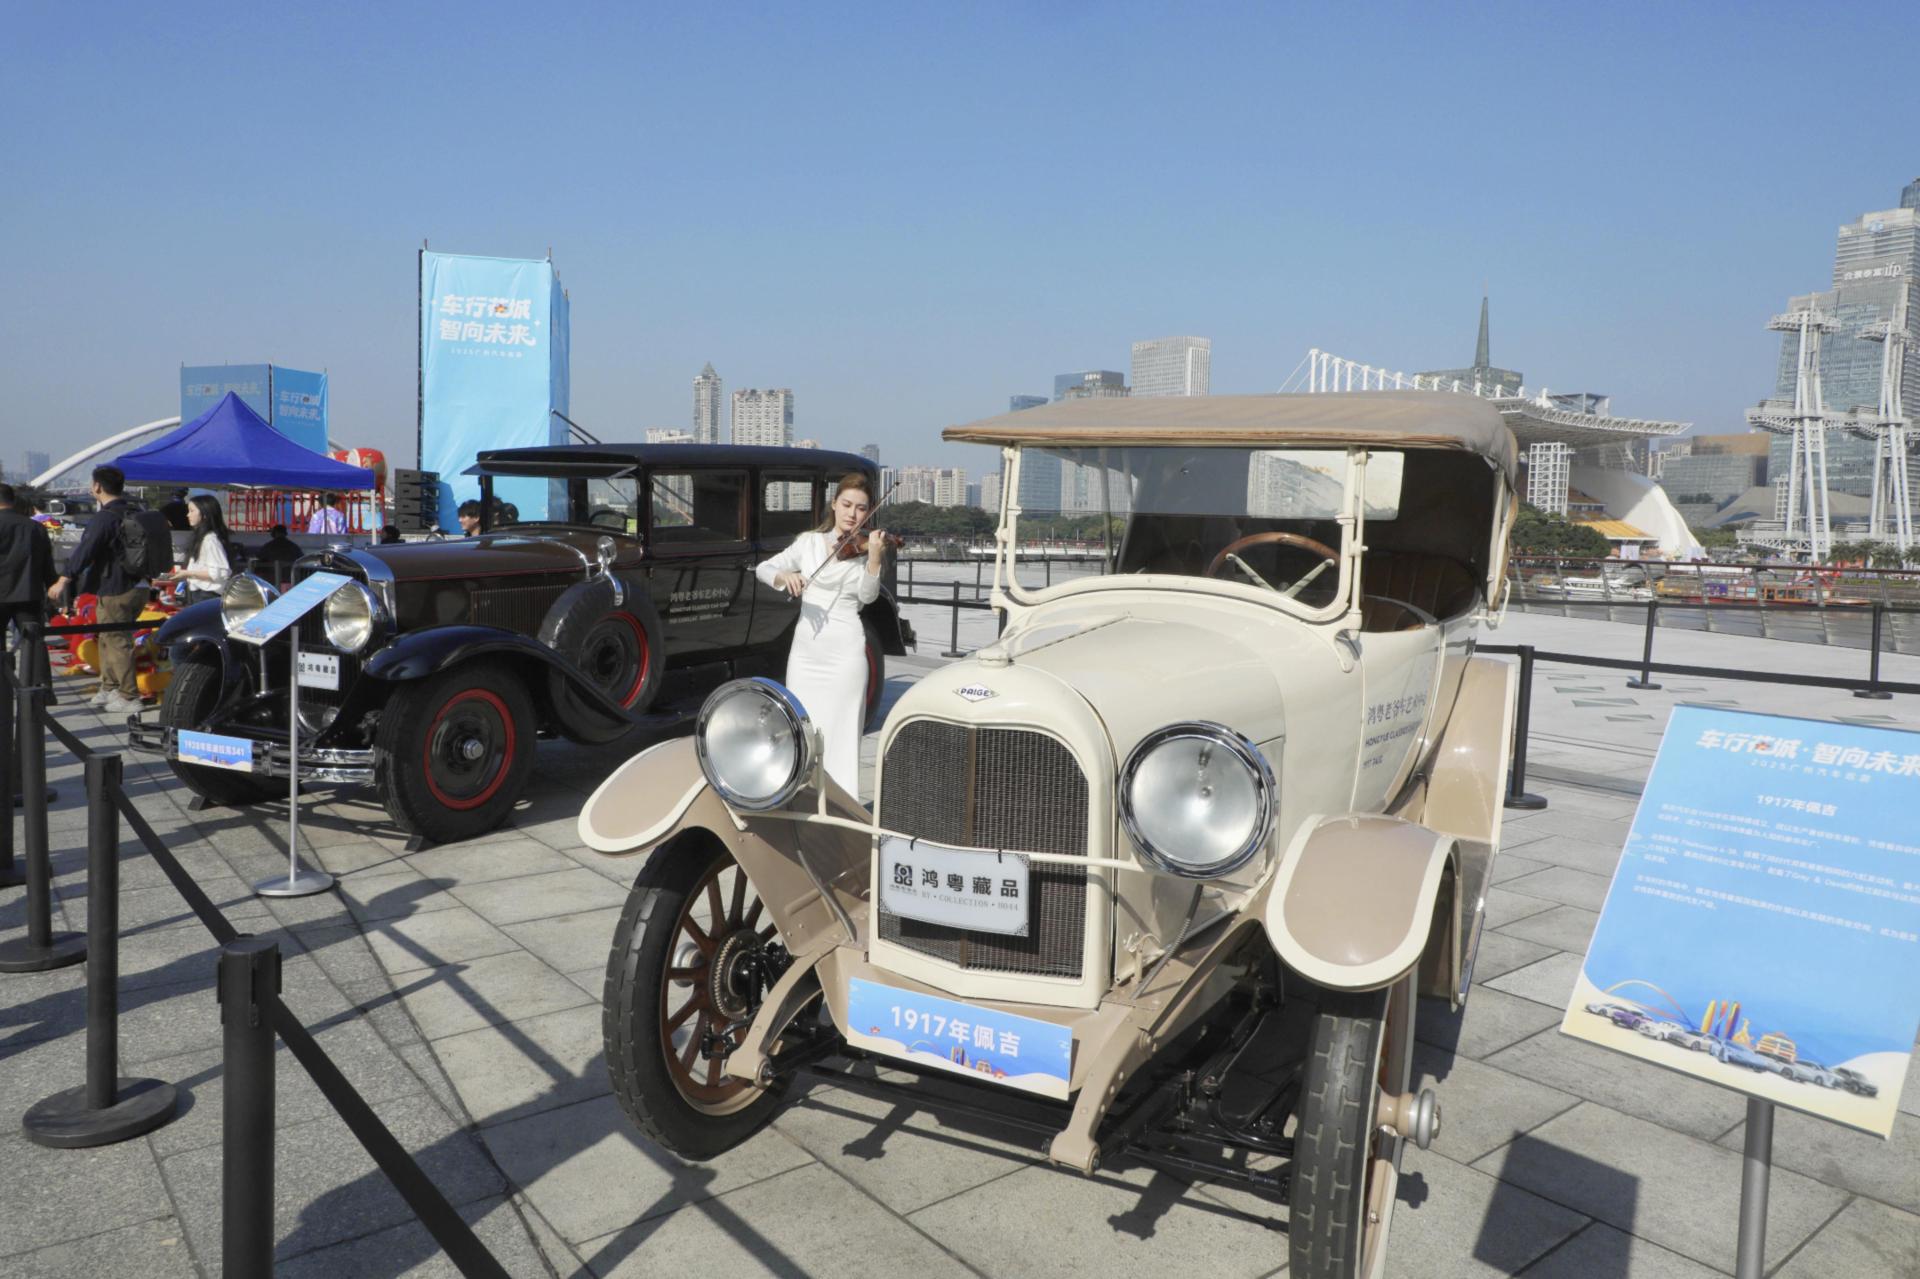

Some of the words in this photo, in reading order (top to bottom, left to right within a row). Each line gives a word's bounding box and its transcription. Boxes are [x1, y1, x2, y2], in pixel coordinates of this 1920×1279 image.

[440, 294, 531, 320] 车行花城
[440, 319, 537, 346] 智向未来
[960, 688, 990, 697] PAIGE
[1757, 794, 1838, 817] 1917年佩吉
[922, 868, 1018, 898] 鸿粤藏品
[891, 1006, 1021, 1057] 1917年佩吉
